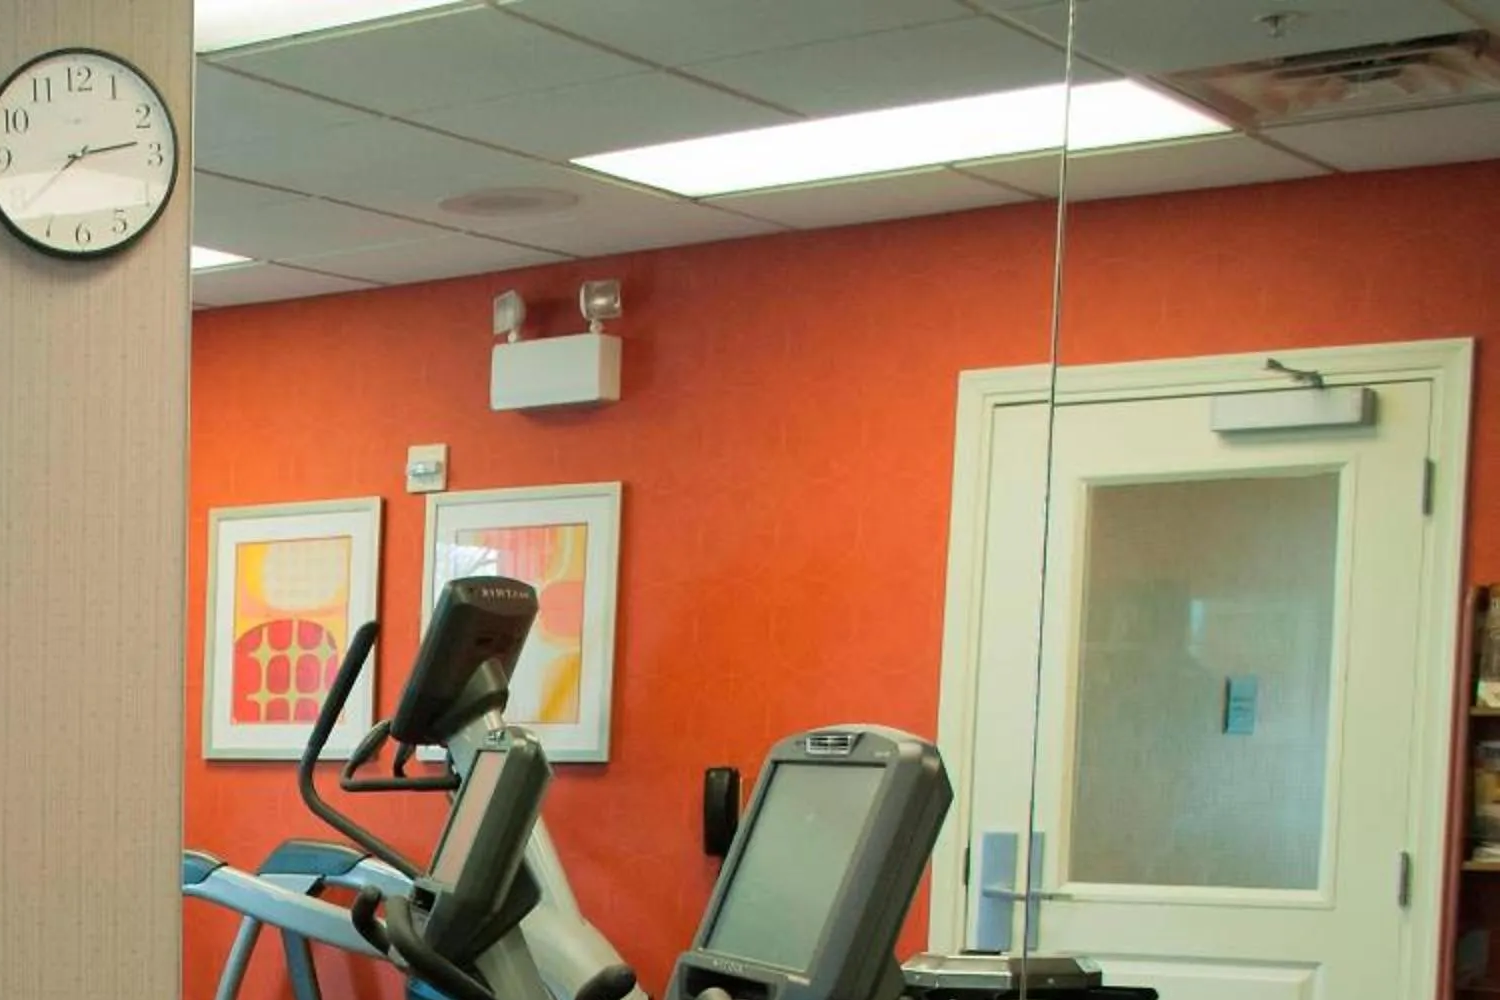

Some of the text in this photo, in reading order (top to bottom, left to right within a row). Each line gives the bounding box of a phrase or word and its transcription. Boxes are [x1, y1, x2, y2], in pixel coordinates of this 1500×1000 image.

[32, 77, 52, 103] 11
[66, 66, 93, 93] 12
[110, 75, 118, 100] 1
[4, 108, 29, 134] 10
[135, 104, 151, 129] 2
[148, 143, 163, 167] 3
[75, 221, 91, 245] 6
[112, 208, 128, 234] 5
